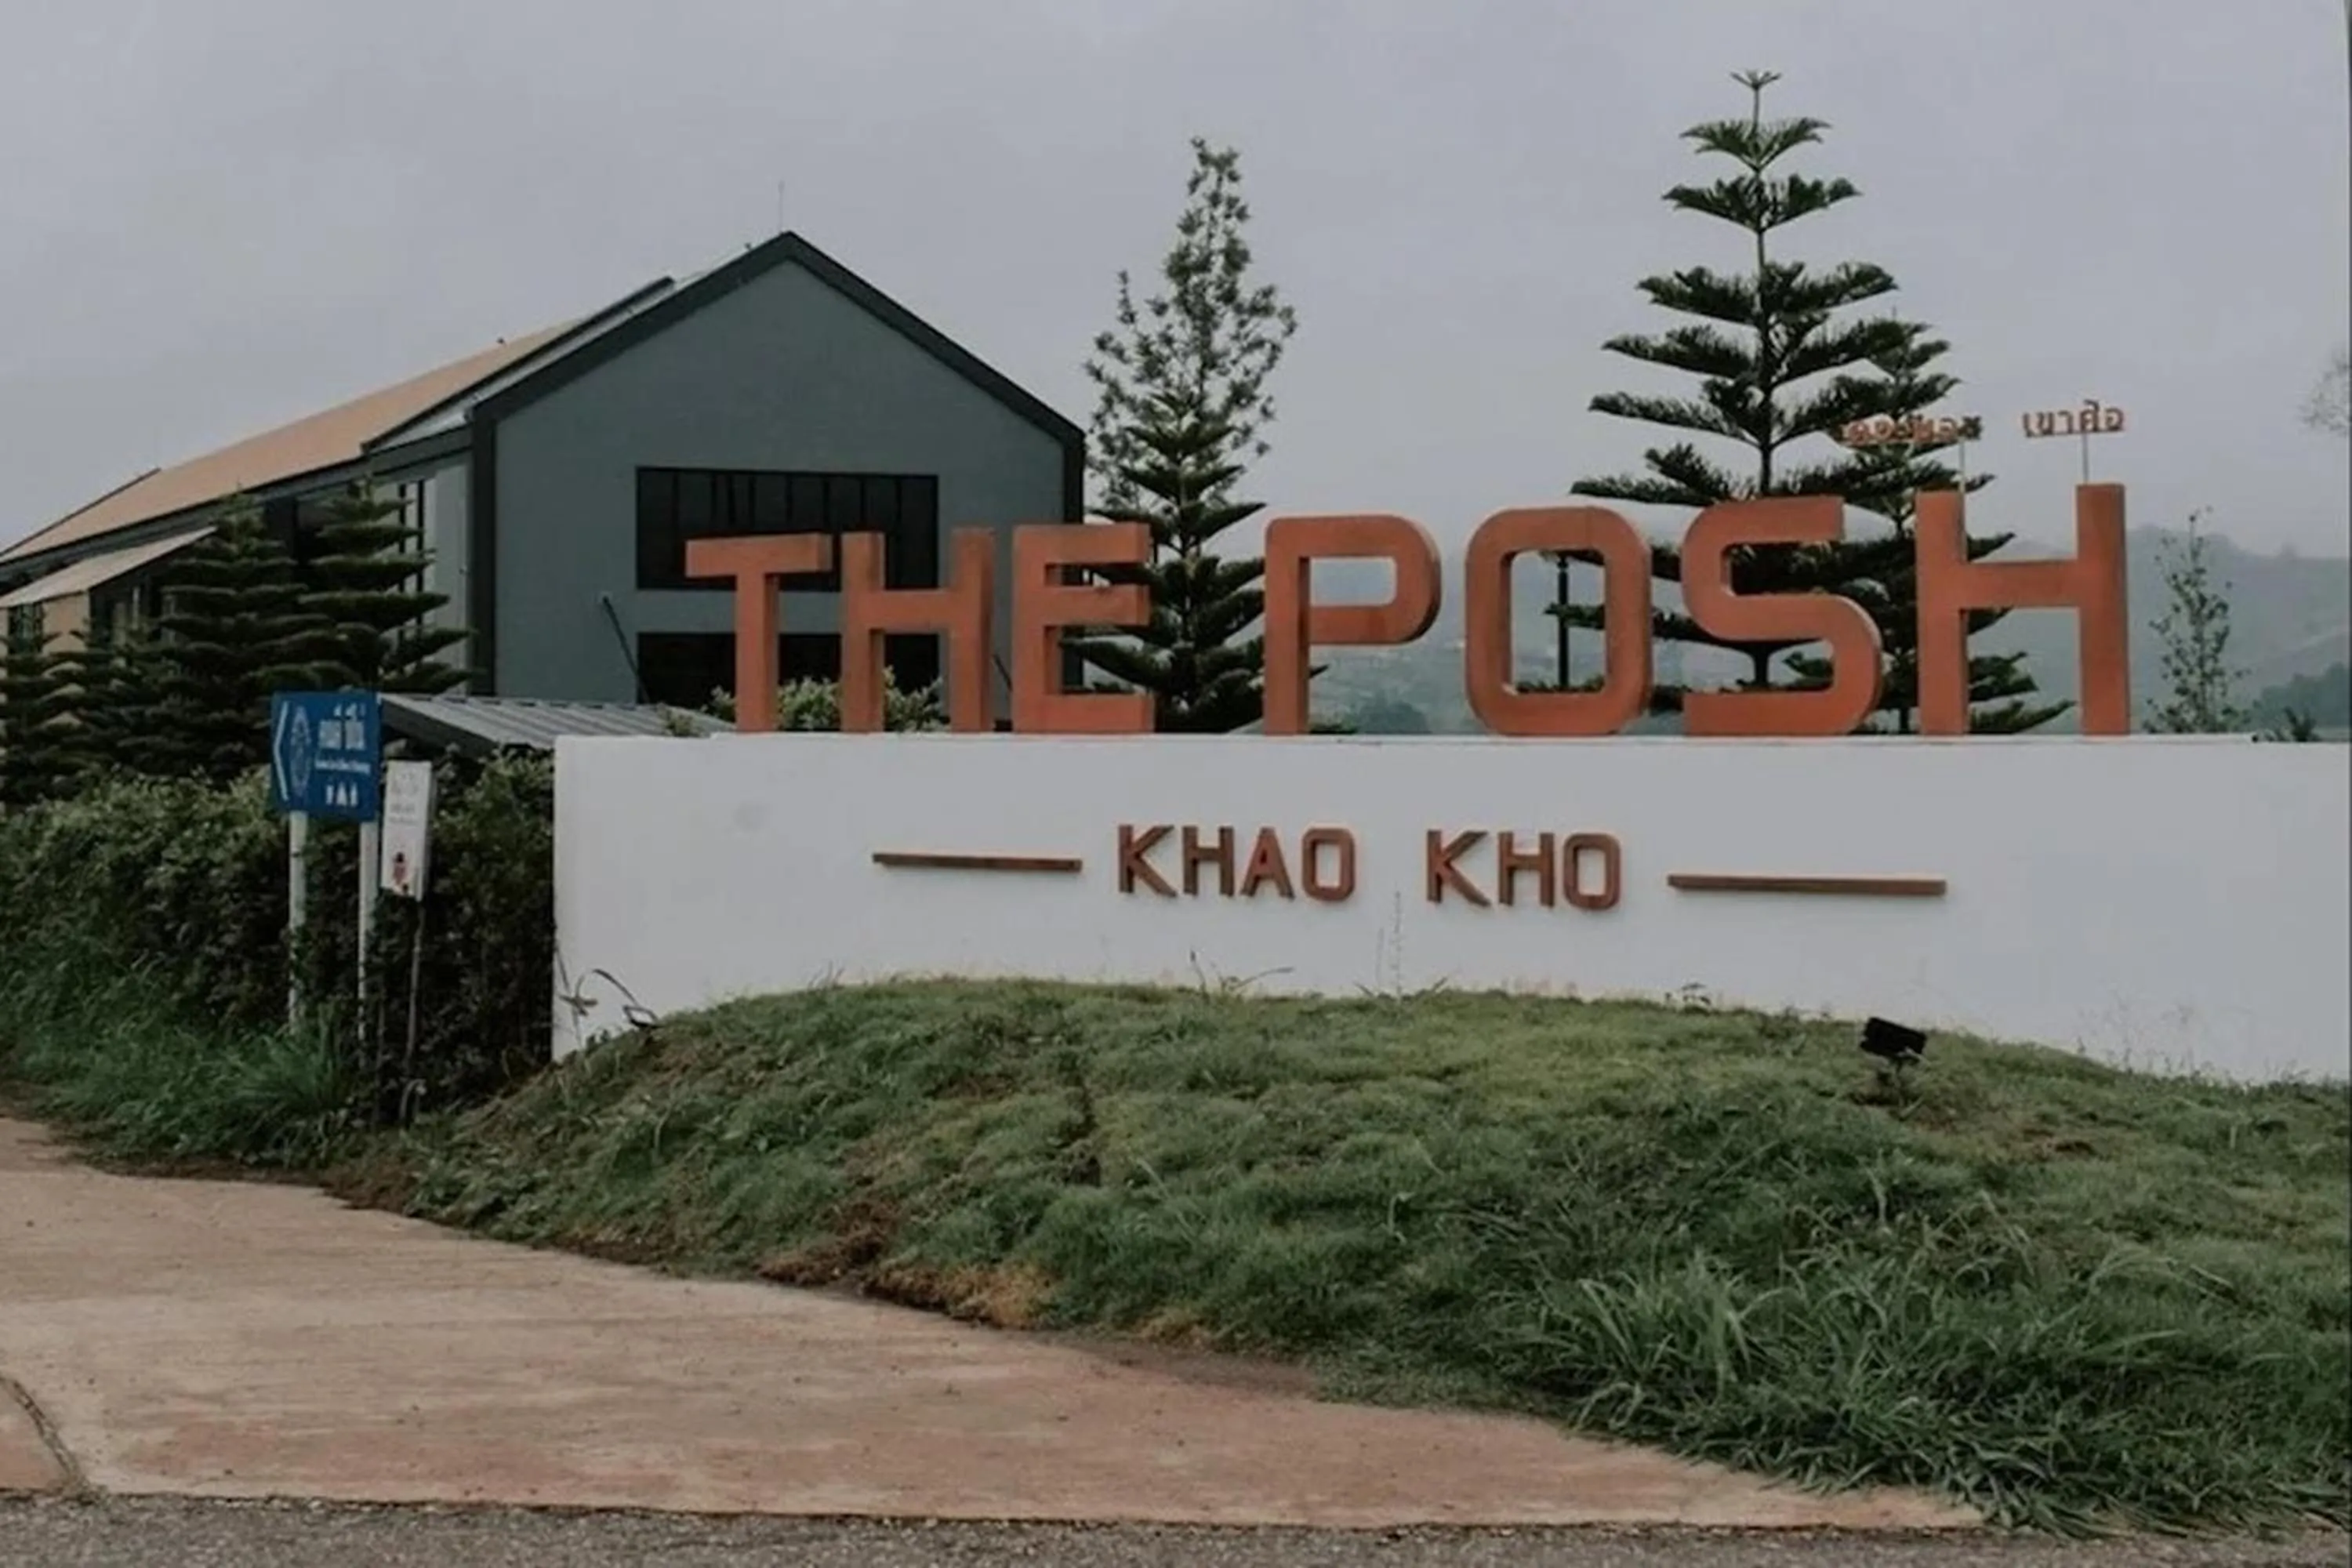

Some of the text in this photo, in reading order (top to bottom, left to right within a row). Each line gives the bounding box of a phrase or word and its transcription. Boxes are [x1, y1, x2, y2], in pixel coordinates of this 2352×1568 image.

[685, 482, 2130, 736] THE POSH
[1118, 823, 1621, 911] KHAO KHO
